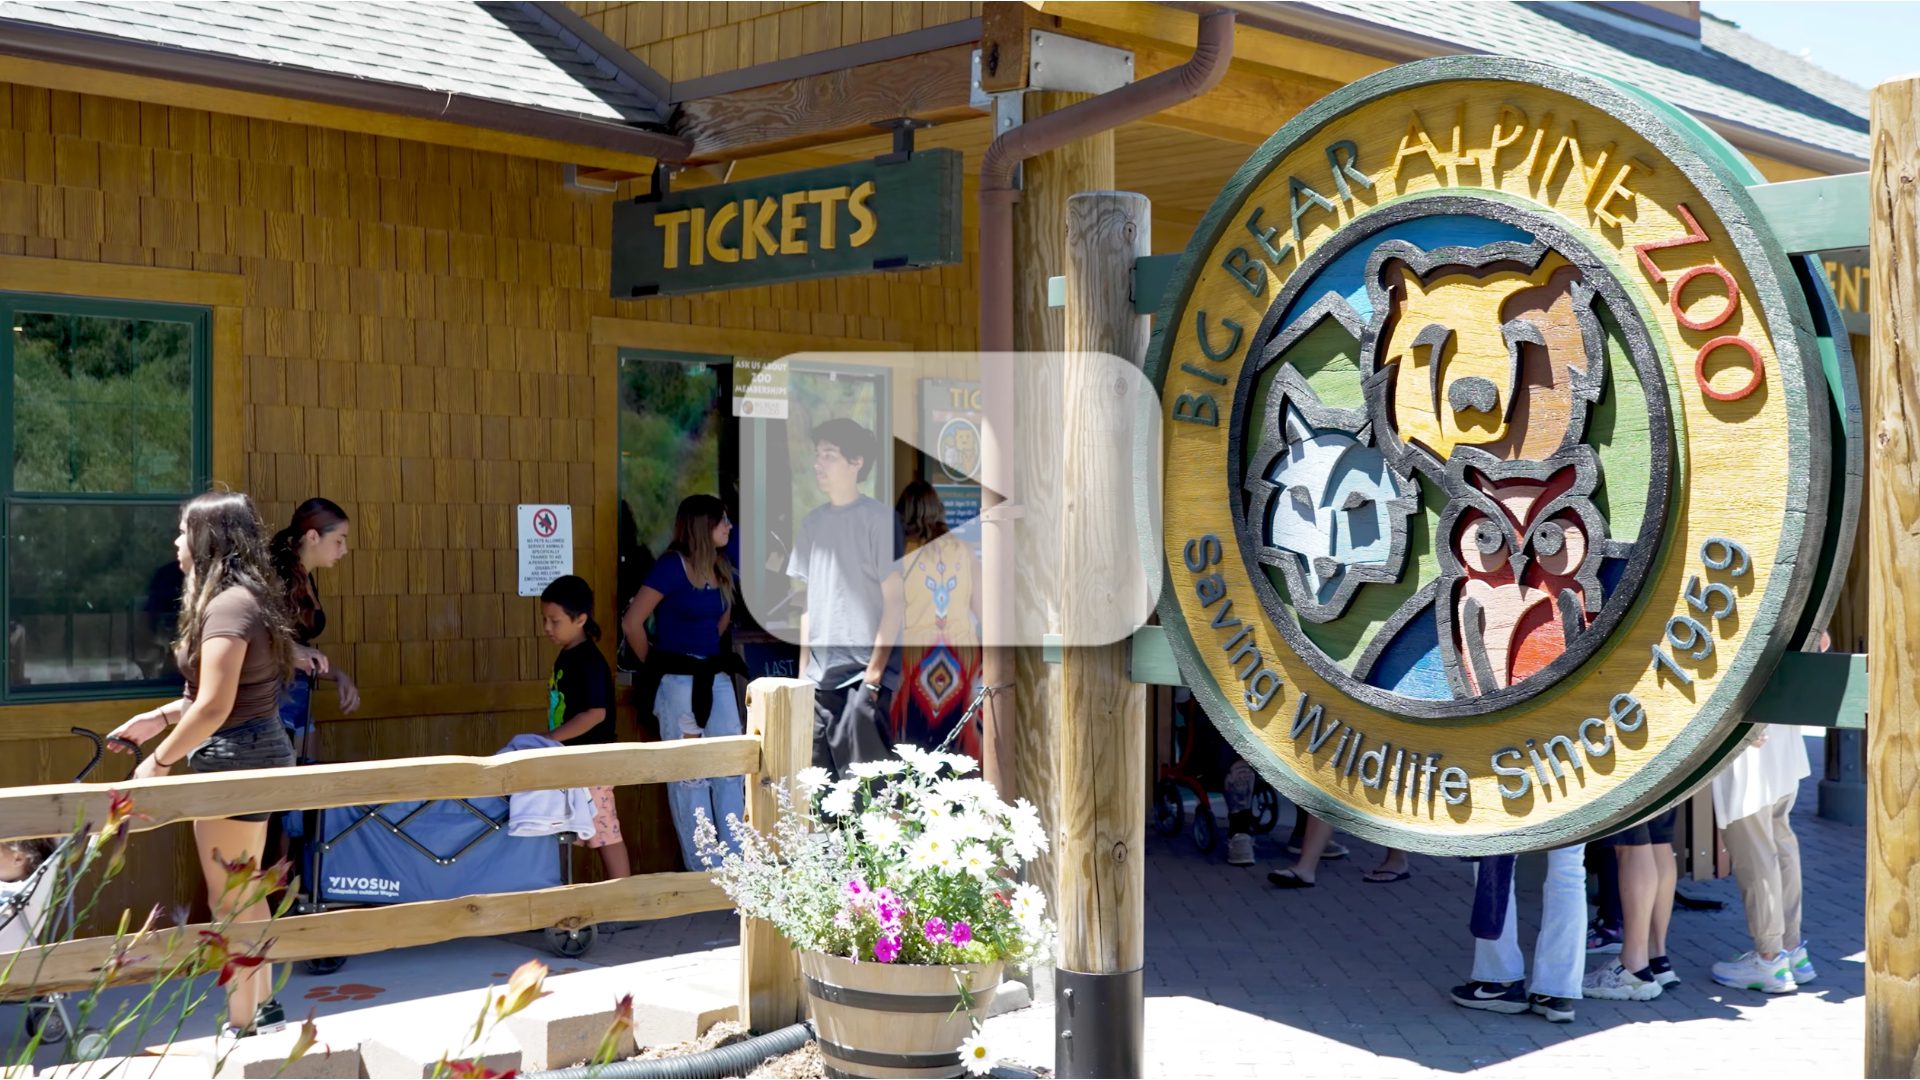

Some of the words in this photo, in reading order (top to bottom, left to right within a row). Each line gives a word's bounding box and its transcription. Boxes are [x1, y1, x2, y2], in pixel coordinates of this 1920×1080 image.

[654, 180, 878, 269] TICKETS
[1173, 310, 1244, 427] BIG
[1221, 139, 1376, 297] BEAR
[1393, 101, 1654, 229] ALPINE
[1634, 202, 1766, 401] ZOO
[735, 361, 750, 369] ASK
[751, 361, 761, 369] US
[762, 362, 787, 371] ABOUT
[752, 372, 772, 383] ZOO
[764, 659, 794, 677] LAST
[1183, 533, 1284, 711] Saving
[1288, 693, 1470, 806] Wildlife
[1490, 692, 1646, 799] Since
[1652, 536, 1752, 685] 1959
[329, 876, 400, 891] VIVOSUN
